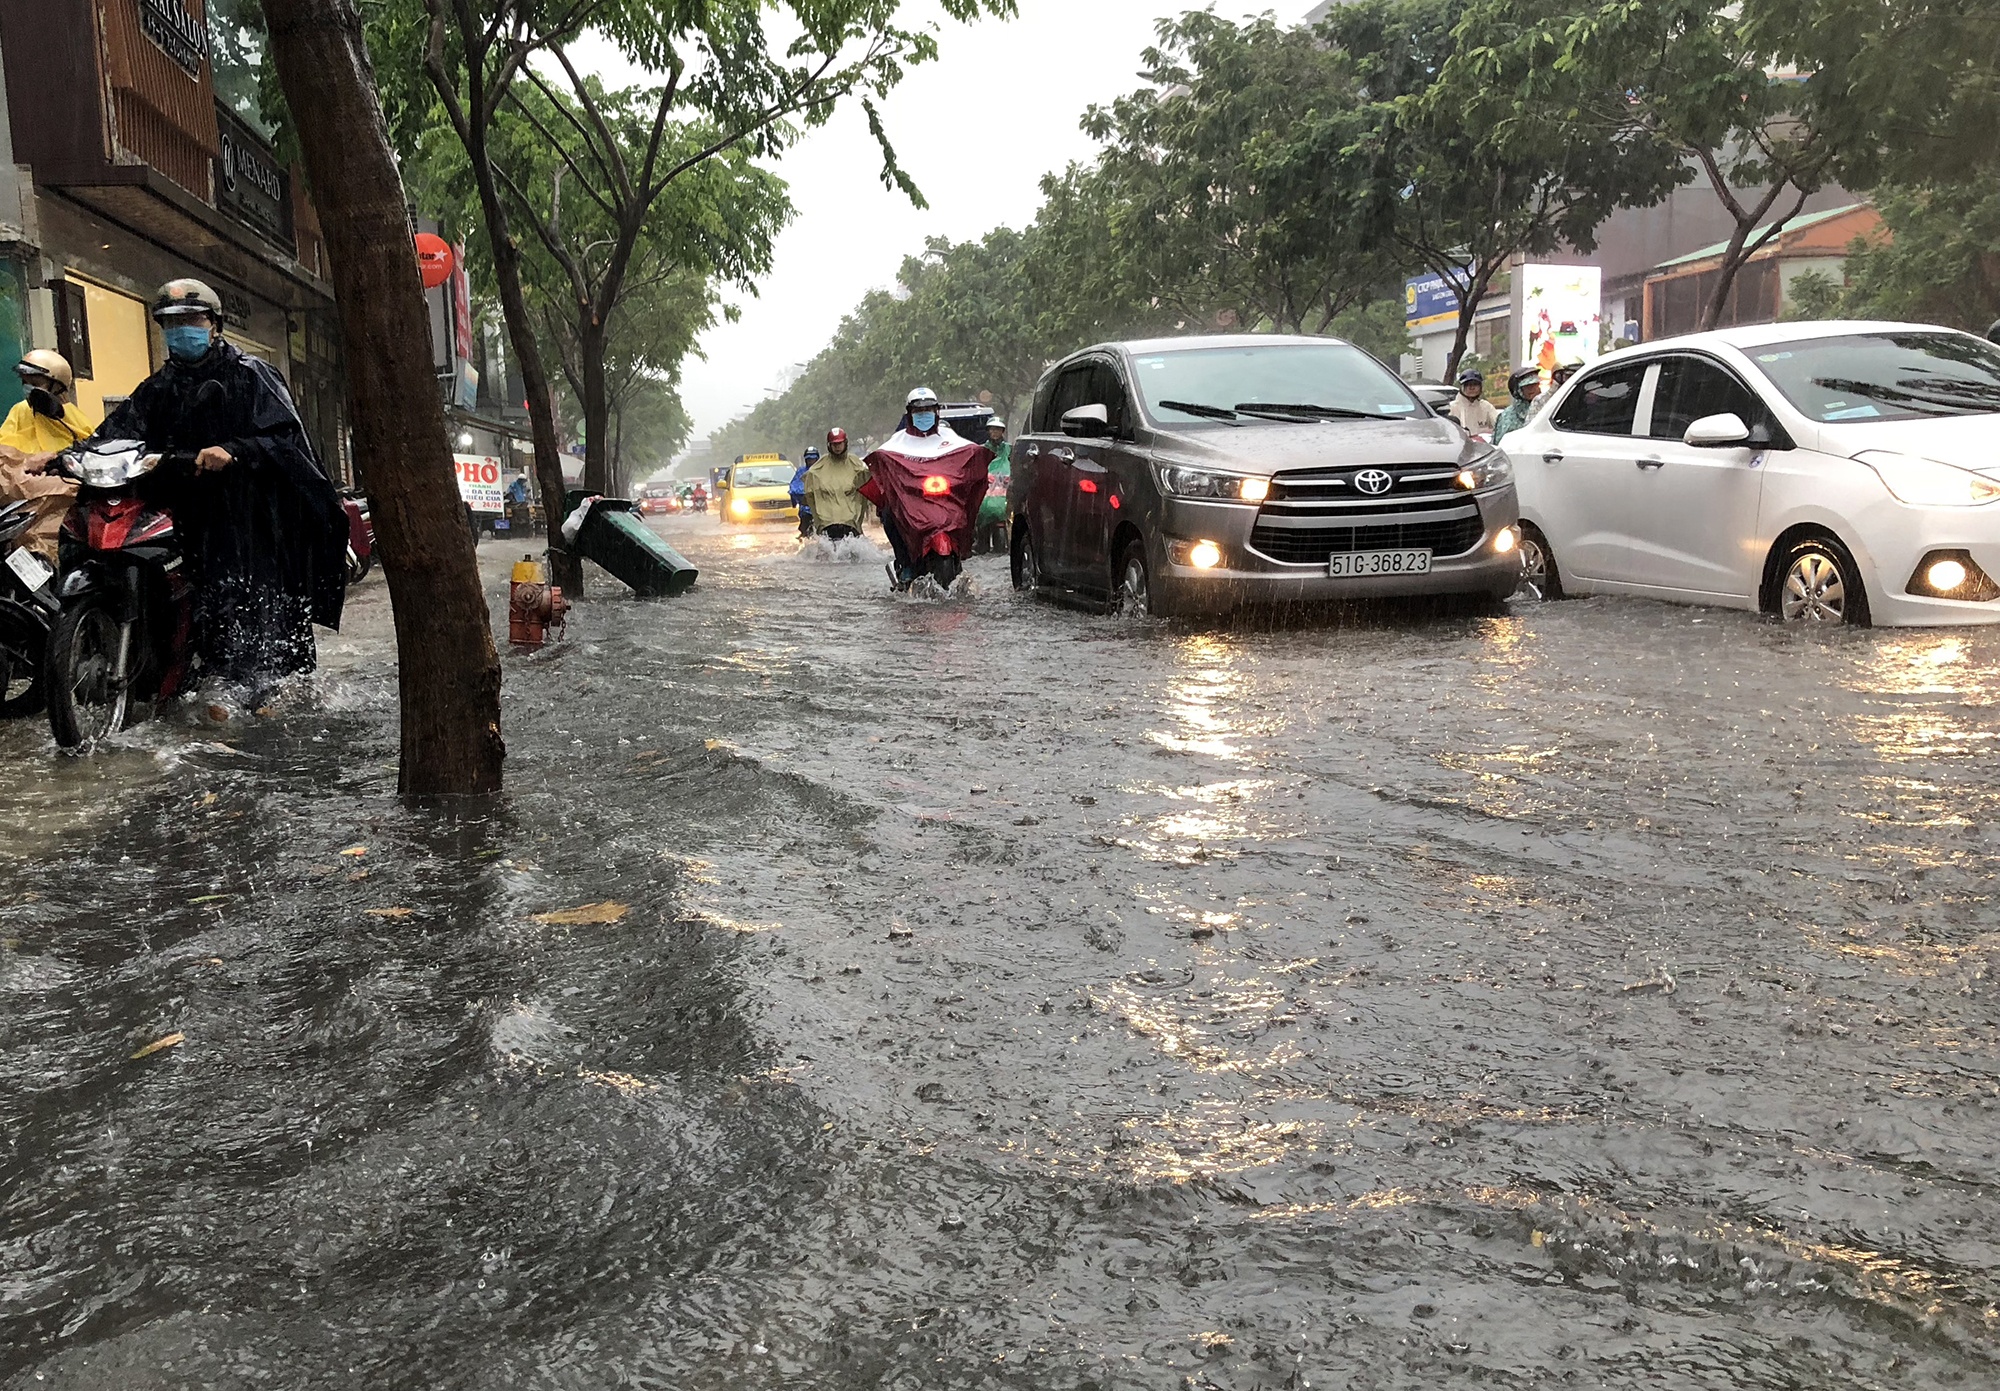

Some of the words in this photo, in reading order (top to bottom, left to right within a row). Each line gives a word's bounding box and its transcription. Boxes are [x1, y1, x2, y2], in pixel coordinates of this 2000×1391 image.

[173, 0, 209, 57] SALON
[236, 144, 280, 201] MENARD
[1332, 553, 1428, 574] 51G-368.23
